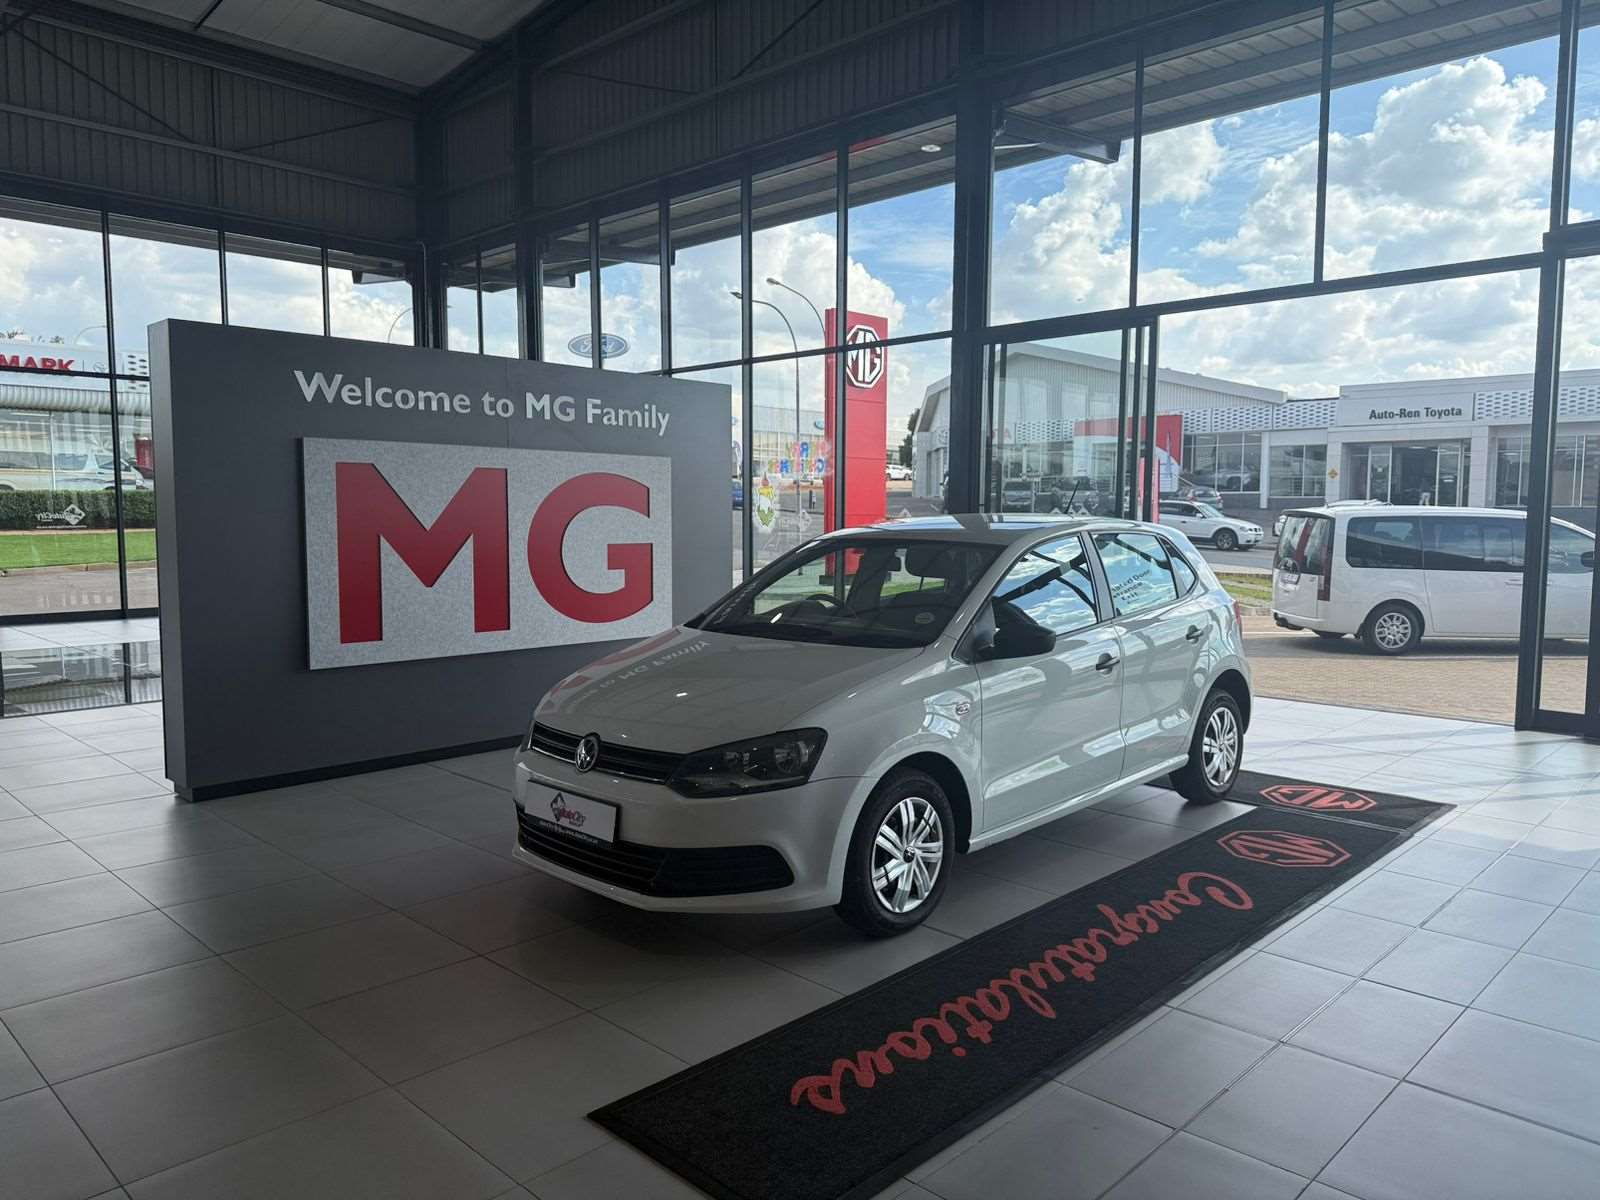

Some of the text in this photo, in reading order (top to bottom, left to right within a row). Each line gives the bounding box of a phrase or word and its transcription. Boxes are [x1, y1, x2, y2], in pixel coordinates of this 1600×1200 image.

[294, 369, 670, 437] Welcome to MG Family
[1368, 406, 1463, 420] Auto-Ren Toyota
[335, 461, 655, 645] MG
[789, 871, 1255, 1115] Congratulations
